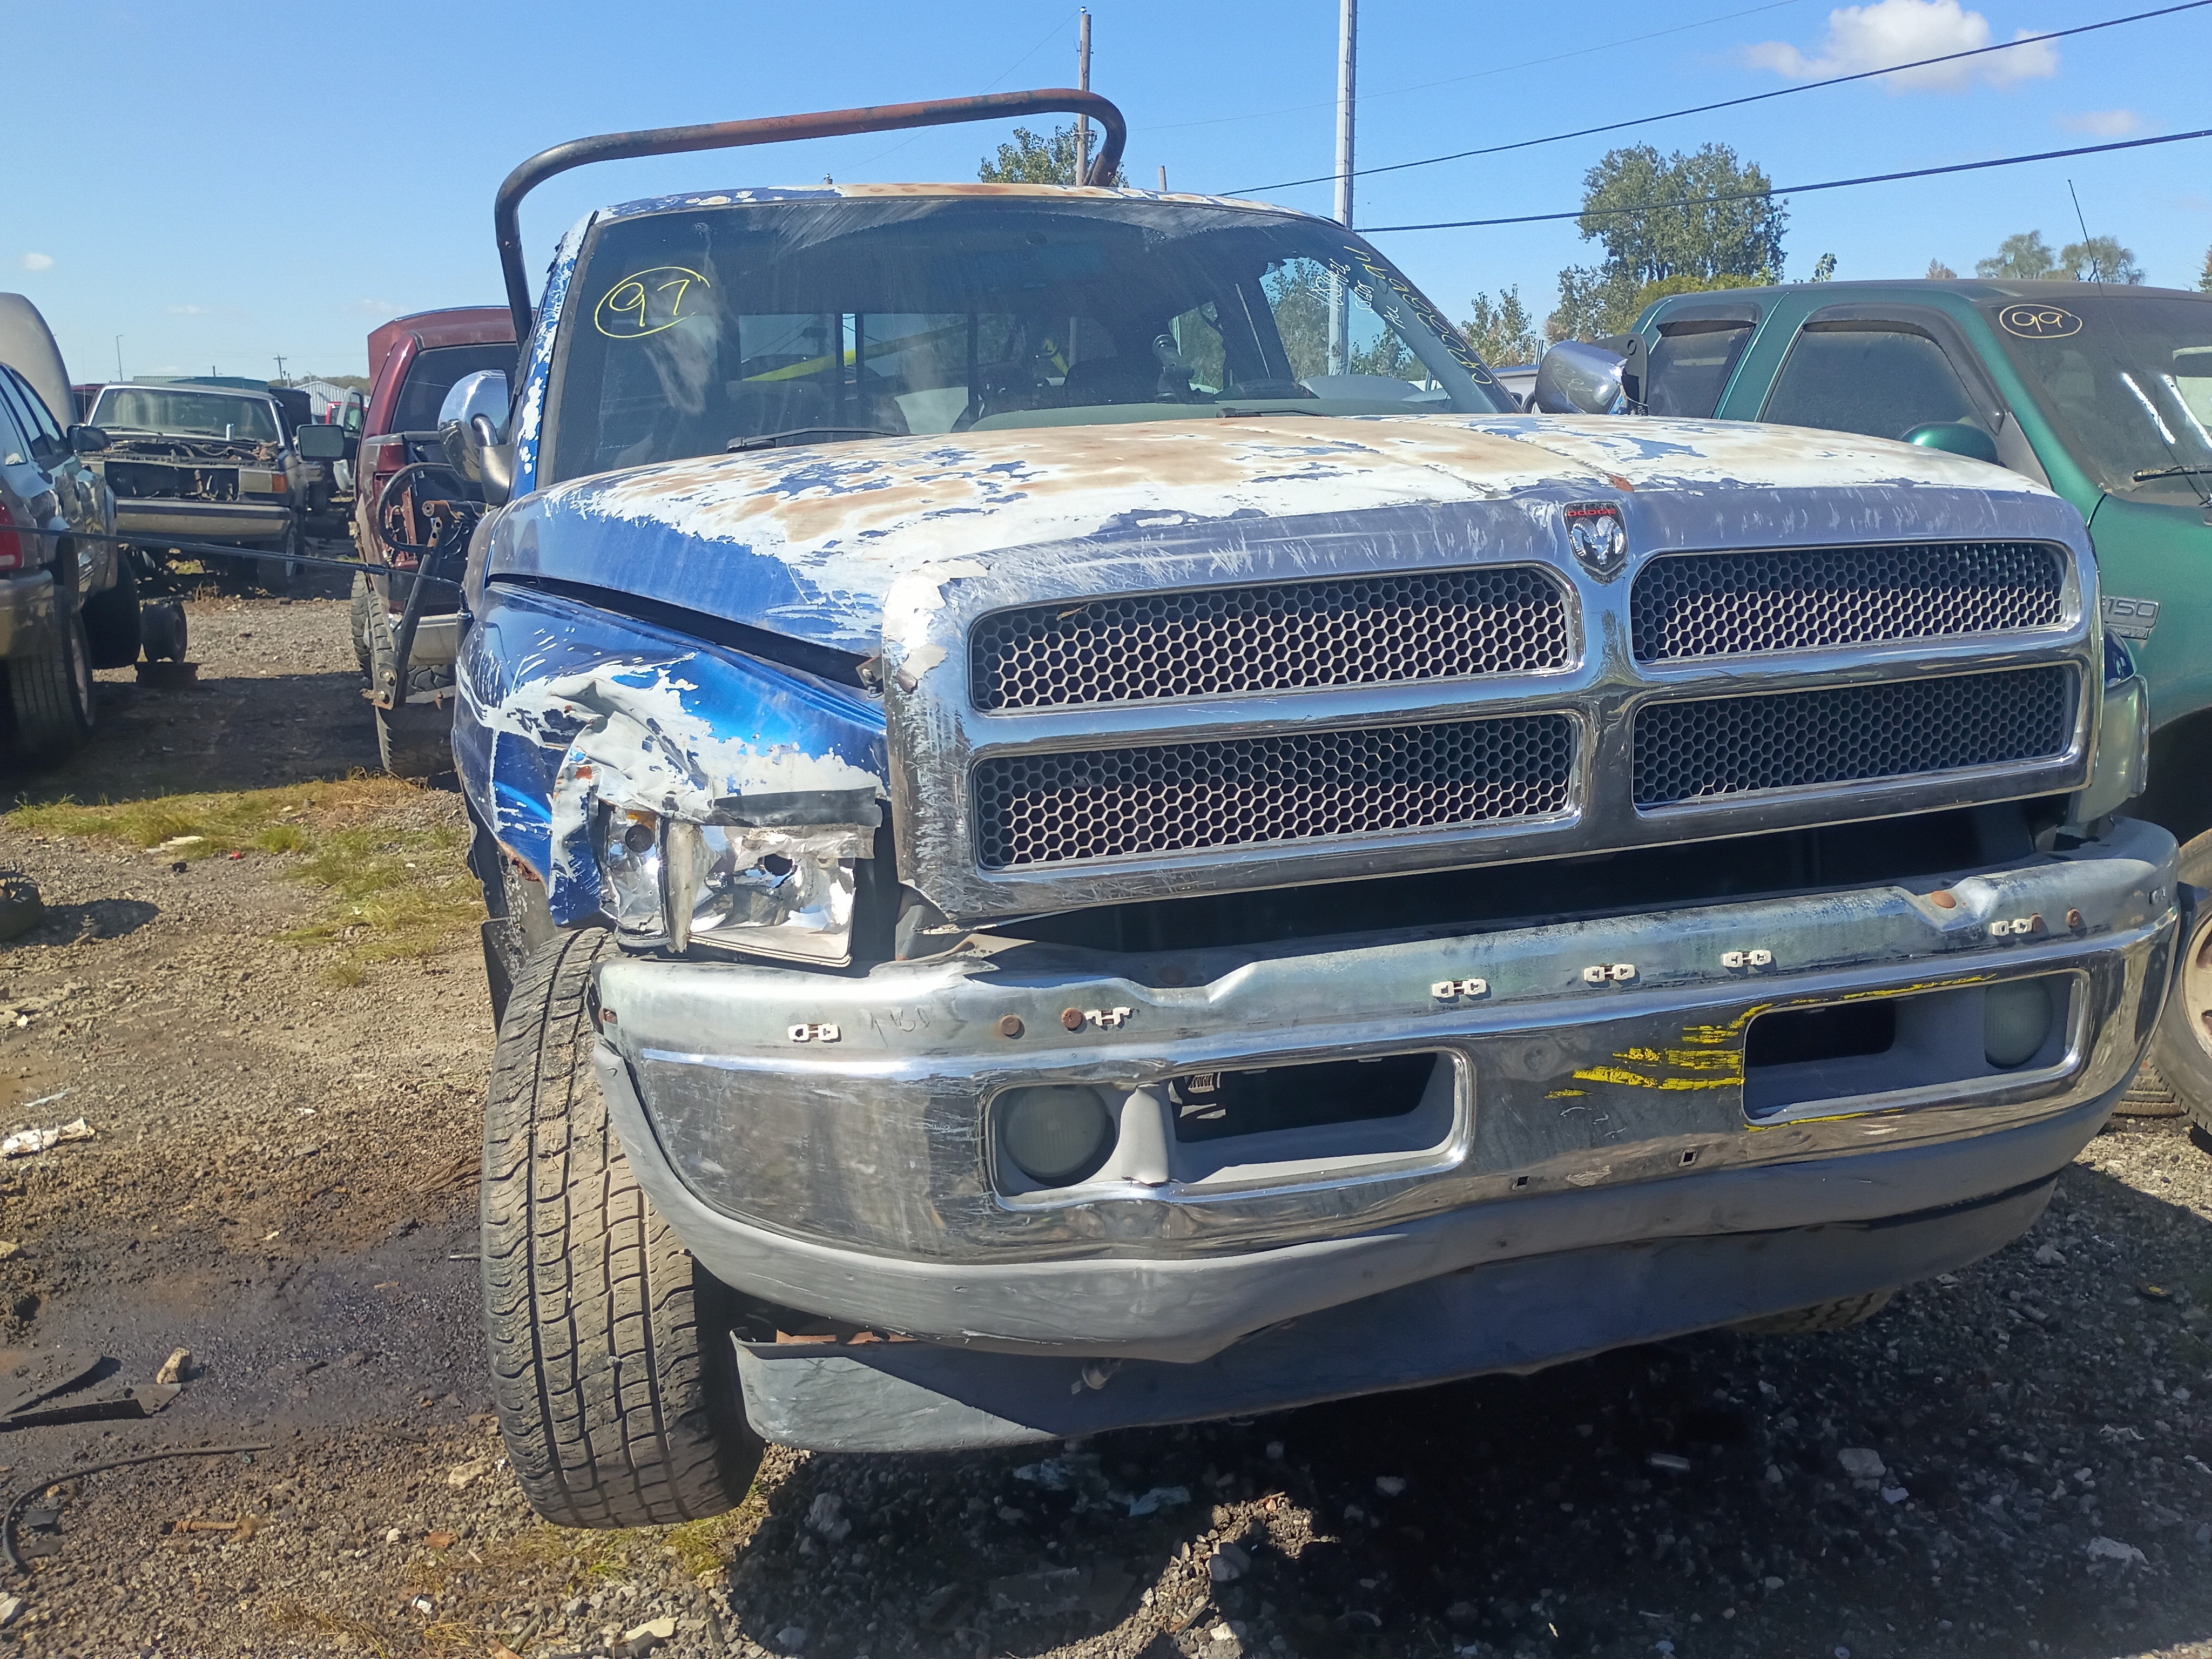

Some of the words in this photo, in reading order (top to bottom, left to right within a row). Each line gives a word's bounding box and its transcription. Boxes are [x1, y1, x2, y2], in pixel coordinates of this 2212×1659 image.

[609, 279, 691, 327] 97
[2012, 311, 2063, 333] 99
[1568, 509, 1616, 517] DODGE
[2102, 595, 2159, 619] 150
